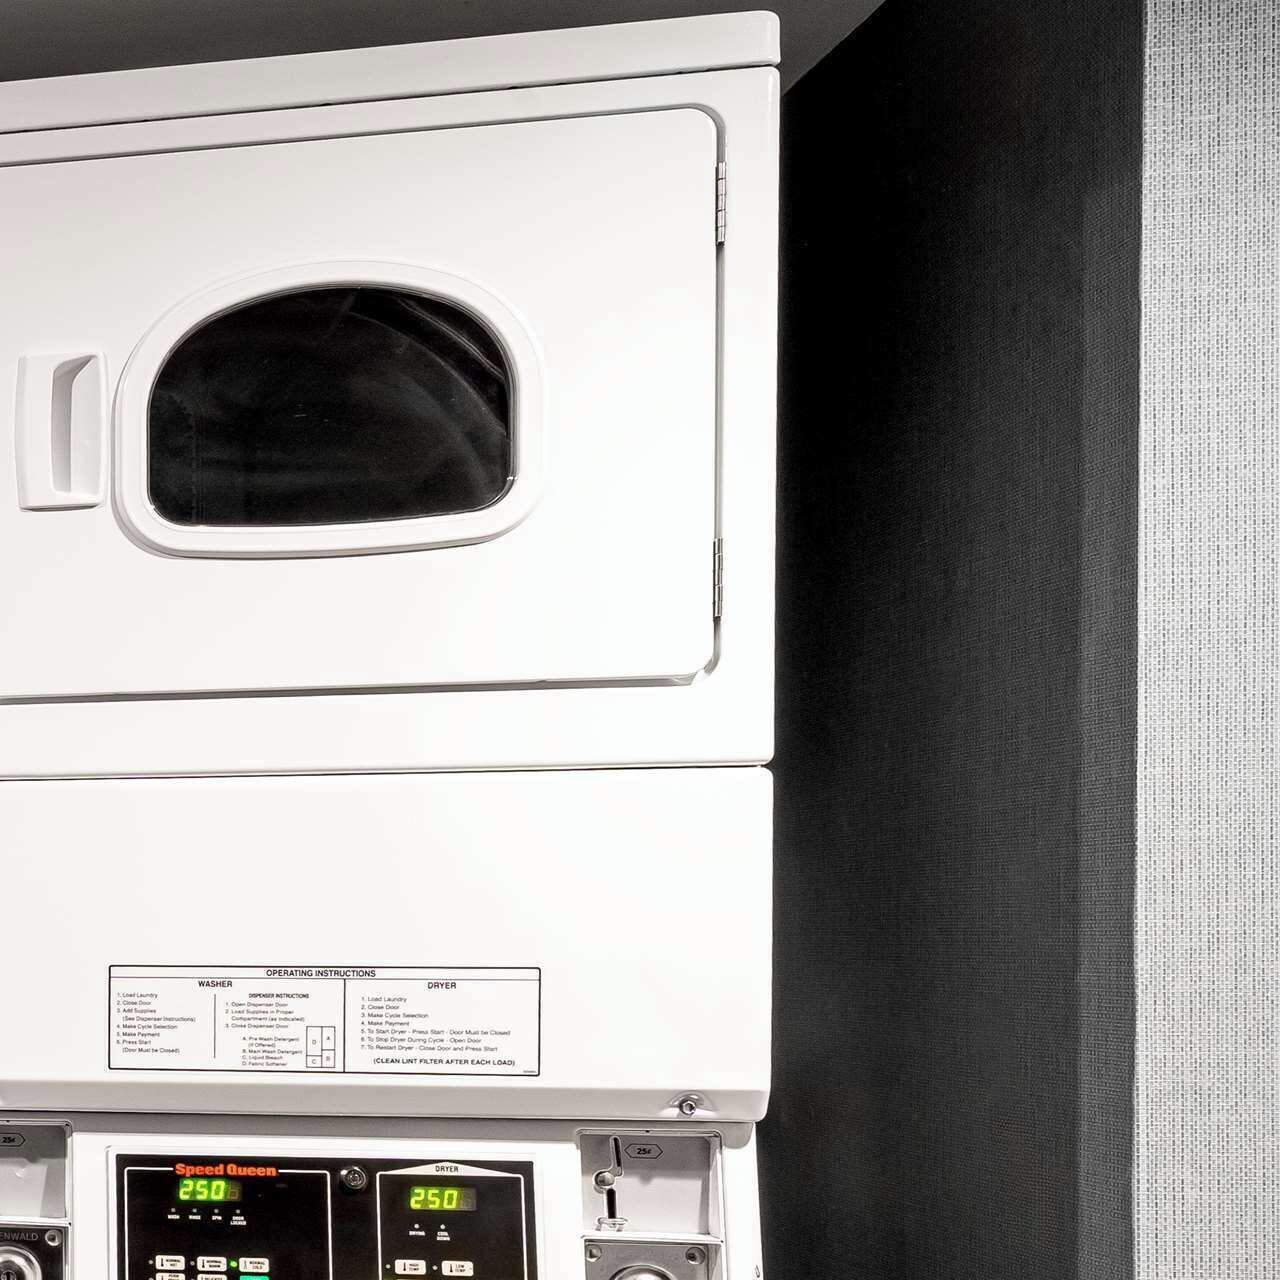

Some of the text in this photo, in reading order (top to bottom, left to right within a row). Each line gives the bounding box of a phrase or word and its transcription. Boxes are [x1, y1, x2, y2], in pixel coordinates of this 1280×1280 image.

[175, 1163, 277, 1177] Speed Queen
[179, 1181, 225, 1200] 250
[410, 1189, 458, 1208] 250
